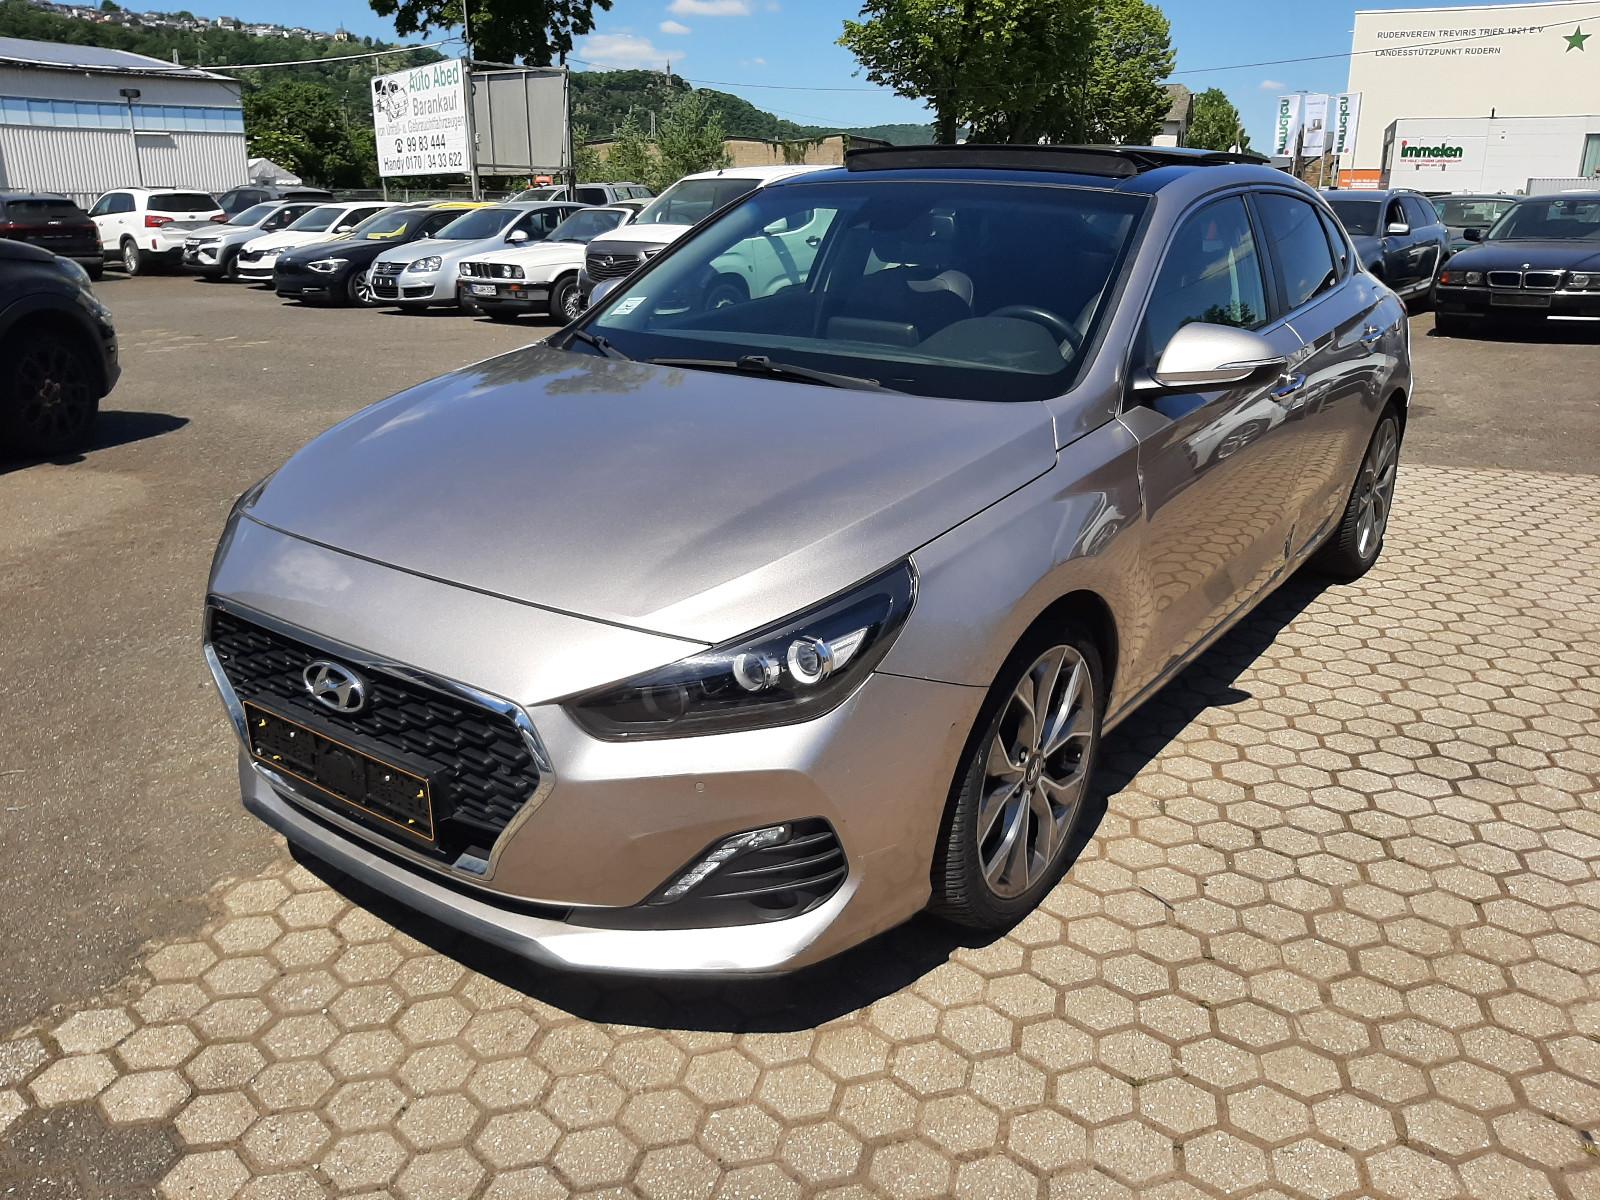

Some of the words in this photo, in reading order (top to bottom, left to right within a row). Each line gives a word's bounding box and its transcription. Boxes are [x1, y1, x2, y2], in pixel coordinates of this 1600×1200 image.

[1377, 30, 1436, 38] RUDERVEREIN
[1439, 29, 1476, 37] TREVIRIS
[1479, 28, 1505, 36] TRIER
[1375, 47, 1461, 56] LANDESSTÜTZPUNKT
[1464, 47, 1501, 56] RUDERN
[409, 72, 430, 92] Auto
[433, 62, 459, 88] Abed
[413, 90, 457, 116] Barankauf
[407, 137, 416, 152] 99
[419, 136, 428, 151] 83
[431, 134, 446, 150] 444
[1401, 140, 1463, 158] immelen
[384, 156, 404, 173] Handy
[428, 154, 436, 168] 34
[438, 153, 447, 168] 33
[449, 152, 462, 167] 622
